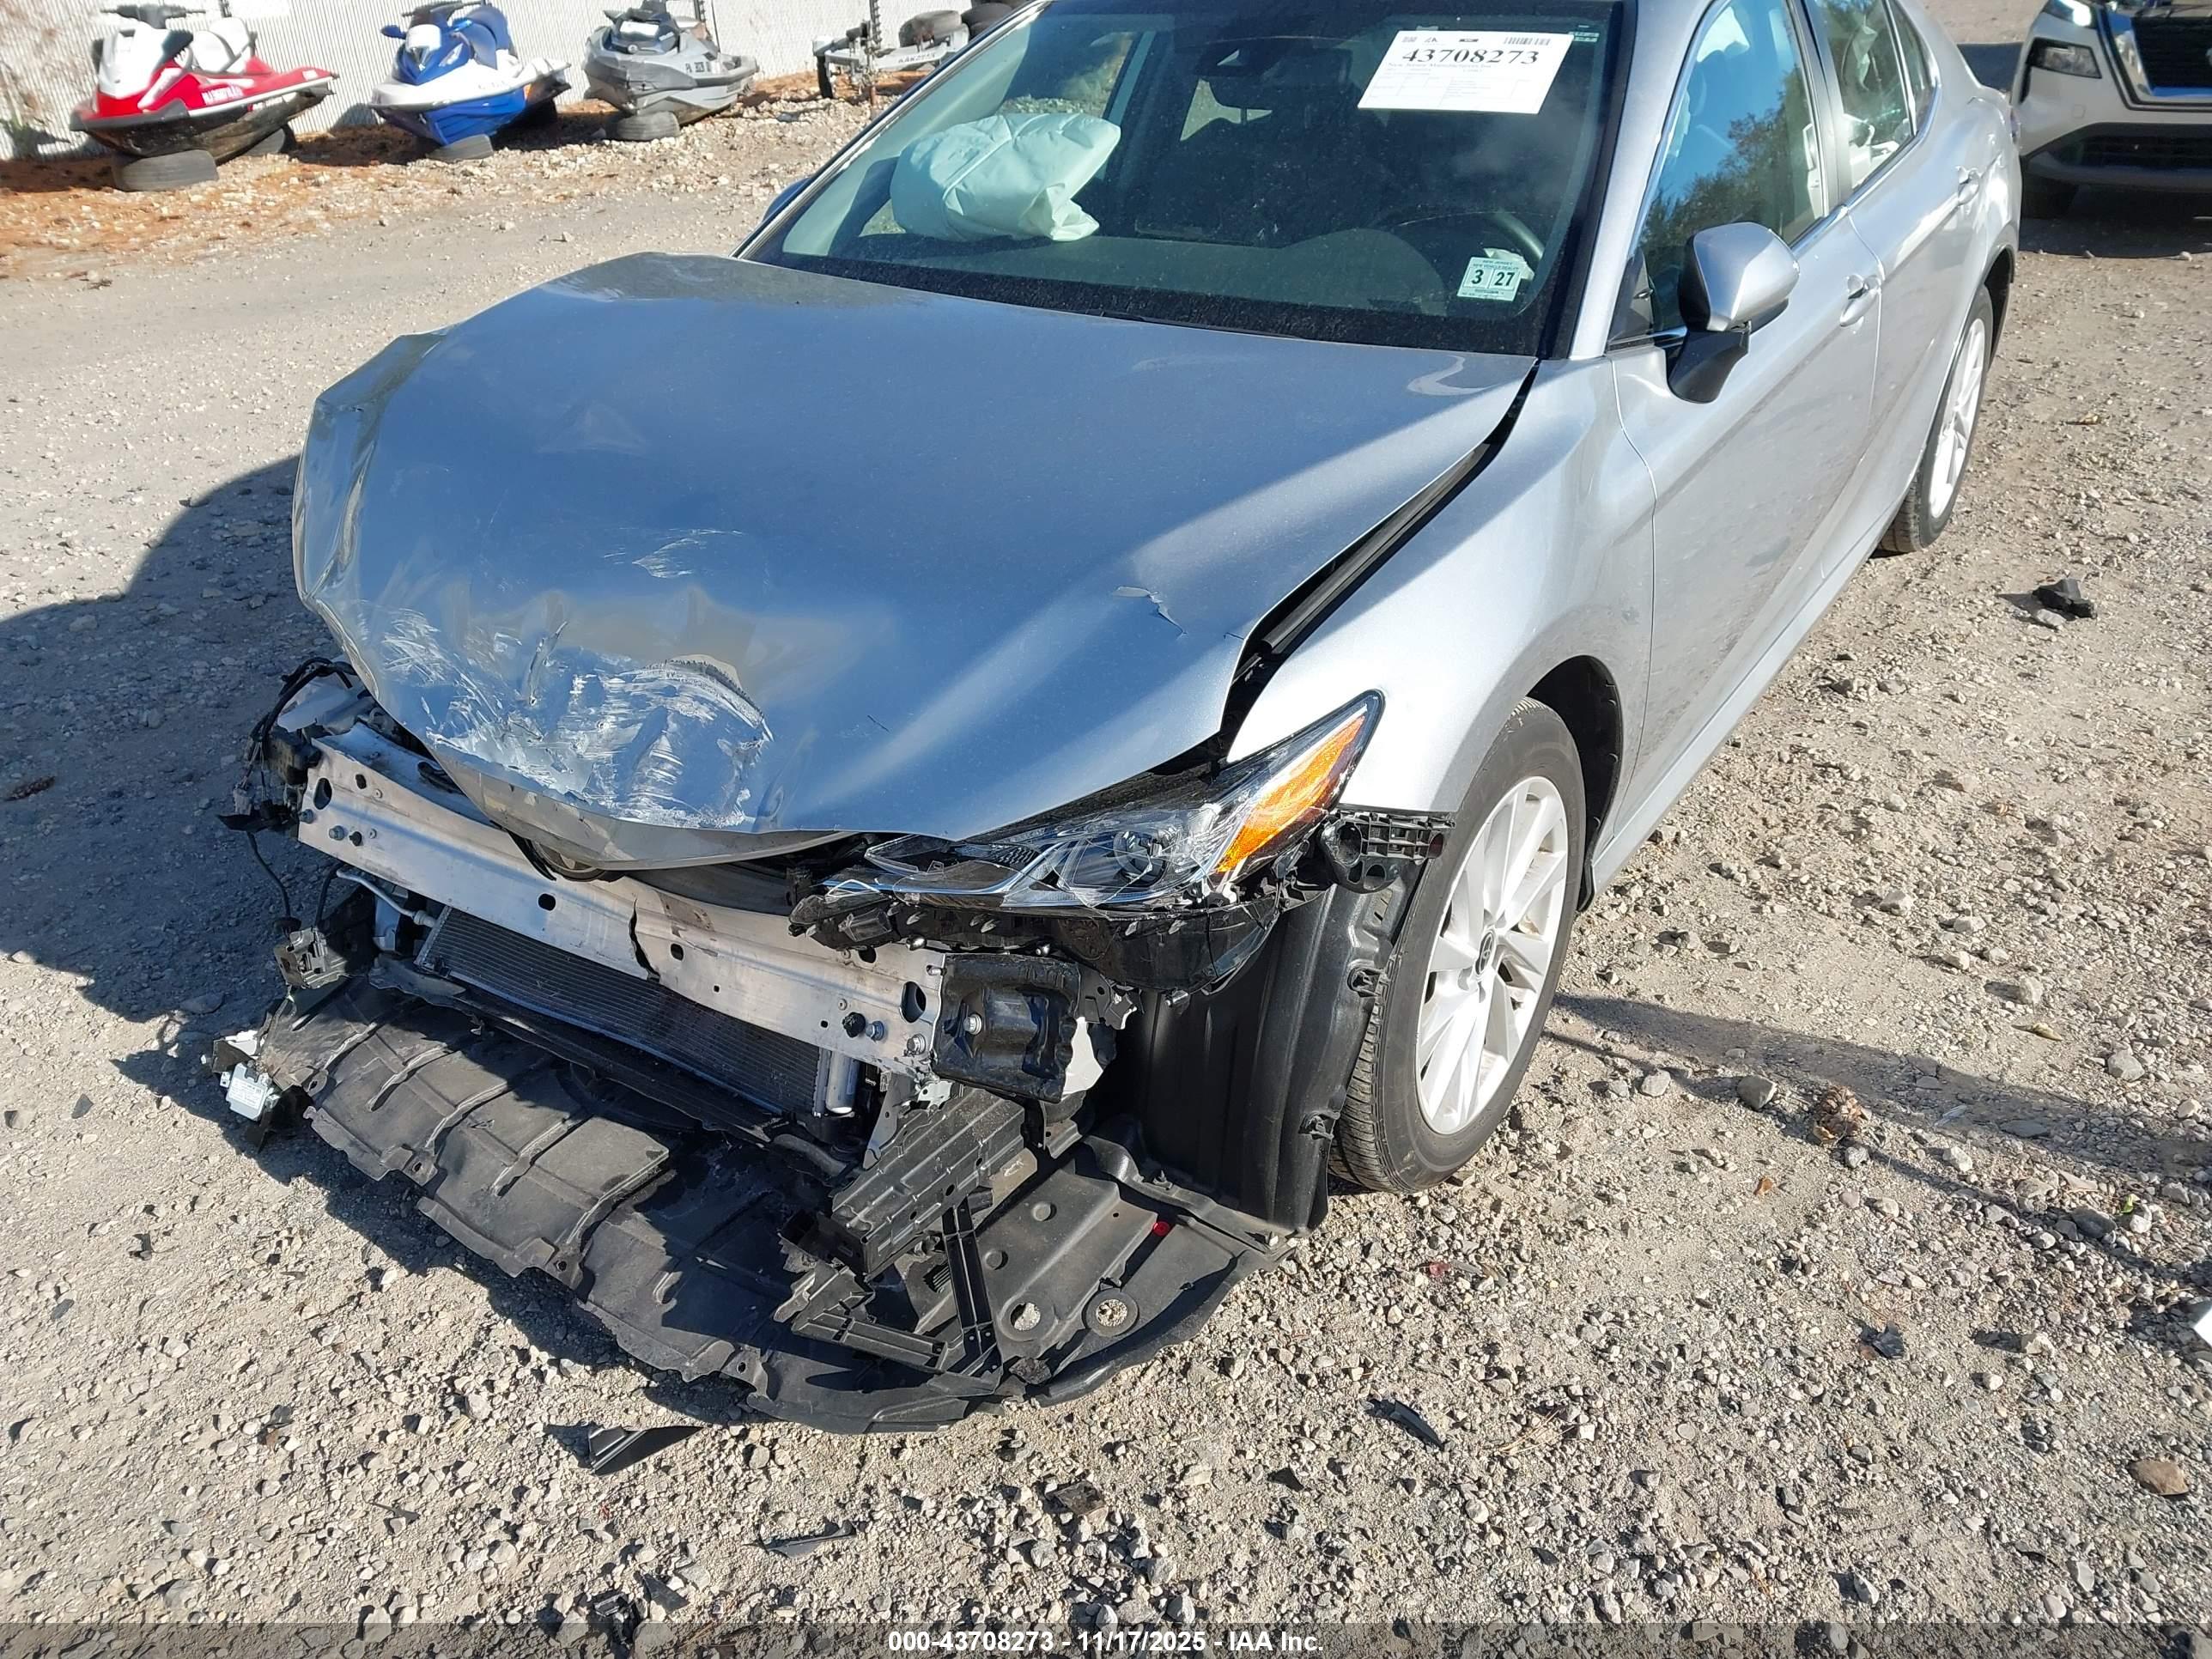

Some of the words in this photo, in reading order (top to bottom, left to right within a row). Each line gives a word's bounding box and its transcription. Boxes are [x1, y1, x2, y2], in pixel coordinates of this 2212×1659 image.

[1401, 48, 1540, 64] 43708273
[1471, 269, 1484, 284] 3
[1494, 271, 1515, 287] 27
